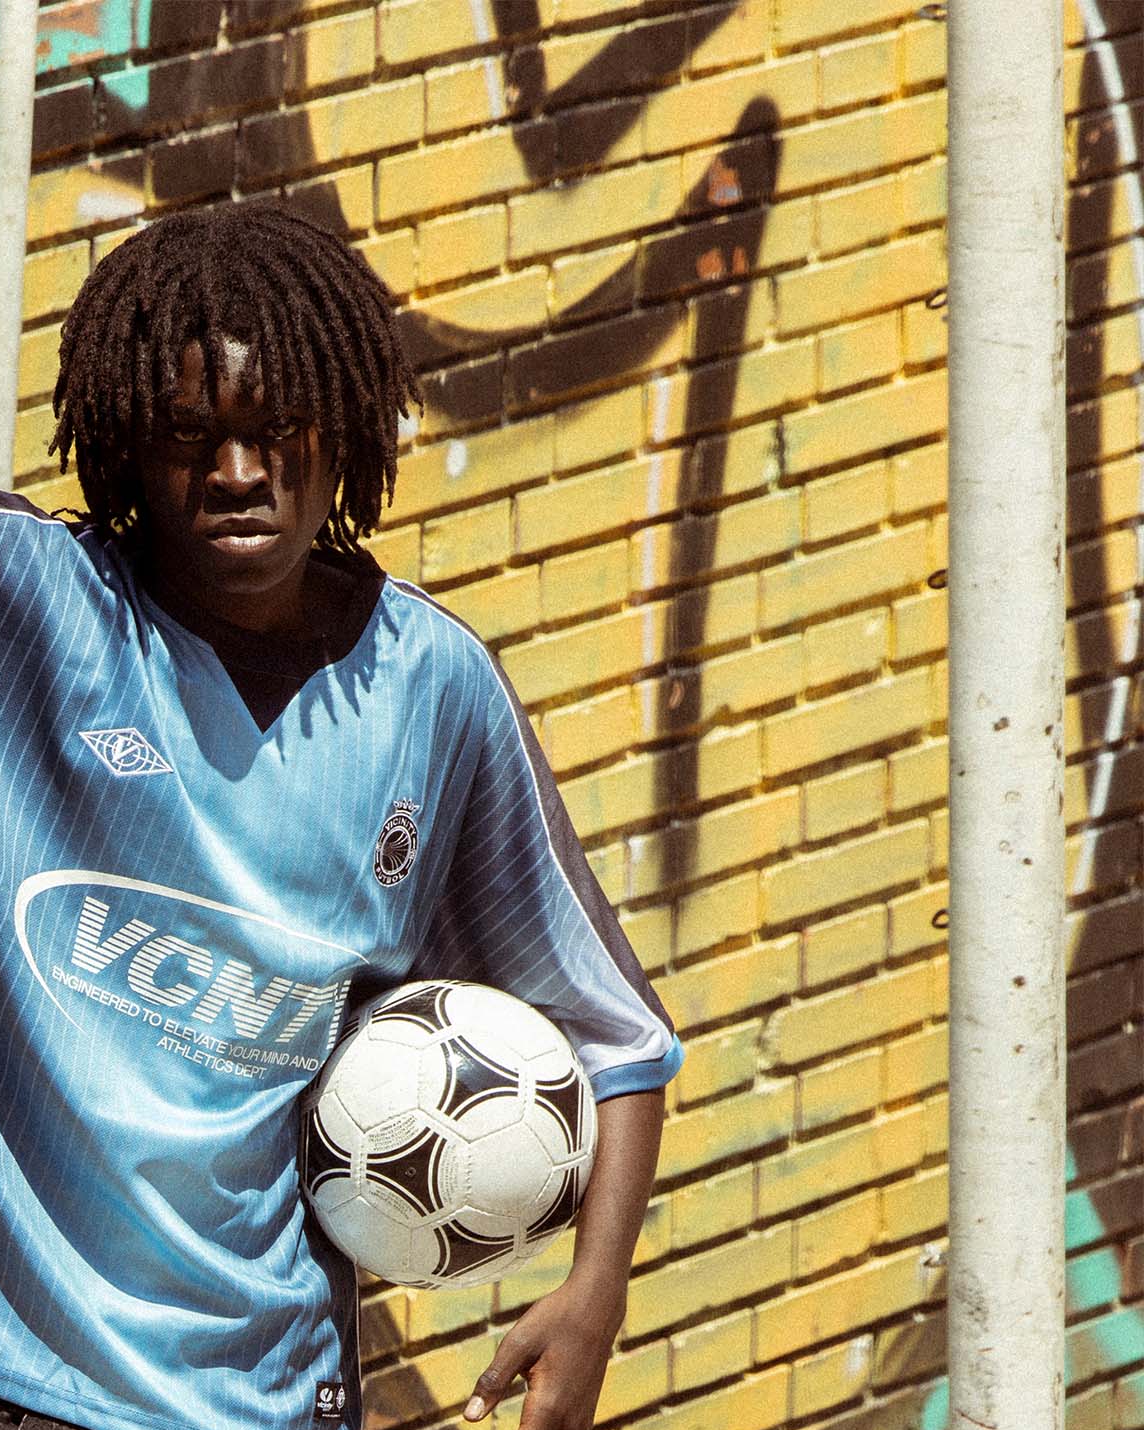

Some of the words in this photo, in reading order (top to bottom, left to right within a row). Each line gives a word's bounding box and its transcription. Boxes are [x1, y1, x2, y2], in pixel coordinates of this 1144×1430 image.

[384, 816, 417, 837] VICINITY
[51, 965, 141, 1018] ENGINEERED
[142, 1008, 163, 1027] TO
[163, 1019, 229, 1054] ELEVATE
[228, 1044, 261, 1060] YOUR
[261, 1051, 290, 1066] MIND
[289, 1055, 319, 1071] AND
[156, 1036, 234, 1074] ATHLETICS
[234, 1062, 266, 1080] DEPT.
